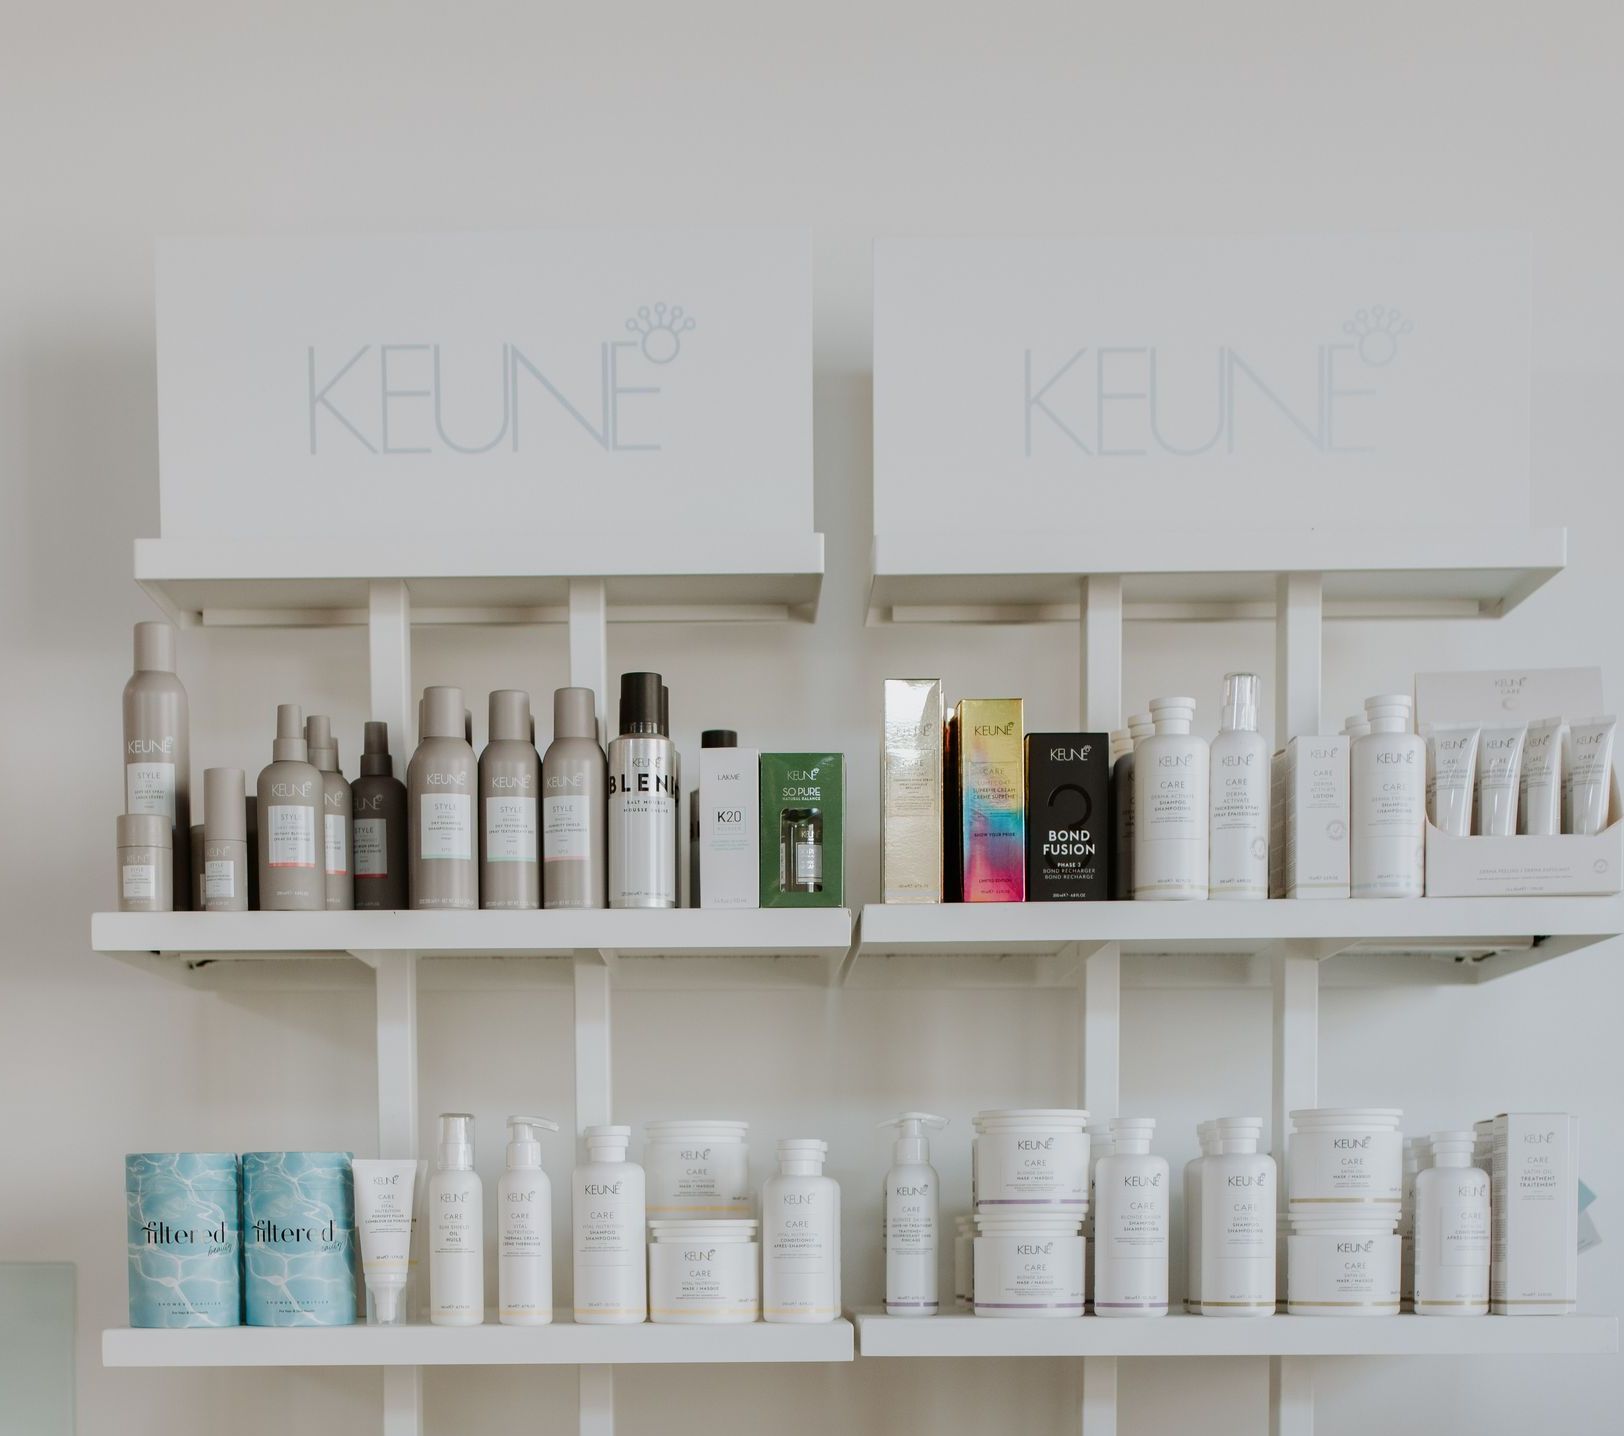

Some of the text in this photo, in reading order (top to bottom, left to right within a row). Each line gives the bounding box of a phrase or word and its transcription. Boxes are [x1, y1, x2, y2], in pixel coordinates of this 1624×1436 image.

[307, 343, 662, 455] KEUNE
[1024, 344, 1377, 457] KEUNE
[975, 725, 1013, 736] KEUNE
[128, 740, 171, 754] KEUNE
[1440, 740, 1466, 750] KEUNE
[1050, 748, 1089, 761] KEUNE
[1311, 750, 1336, 758] KEUNE
[1376, 753, 1414, 764] KEUNE
[633, 758, 661, 768] KEUNE
[1159, 755, 1192, 767] KEUNE
[1222, 755, 1251, 766] KEUNE
[427, 773, 465, 785] KEUNE
[788, 770, 816, 780] KEUNE
[492, 776, 529, 788] KEUNE
[547, 776, 583, 787] KEUNE
[1161, 781, 1185, 789] CARE
[272, 784, 311, 797] KEUNE
[783, 787, 820, 796] SO PURE
[1049, 831, 1090, 841] BOND
[1044, 844, 1095, 855] FUSION
[1018, 1140, 1052, 1150] KEUNE
[1334, 1139, 1370, 1148] KEUNE
[1124, 1176, 1160, 1187] KEUNE
[1228, 1176, 1265, 1187] KEUNE
[585, 1184, 620, 1195] KEUNE
[897, 1186, 927, 1196] KEUNE
[1130, 1202, 1154, 1210] CARE
[141, 1221, 225, 1244] filtered
[252, 1220, 334, 1243] filtered
[1017, 1245, 1052, 1254] KEUNE
[1337, 1243, 1373, 1253] KEUNE
[684, 1251, 714, 1261] KEUNE
